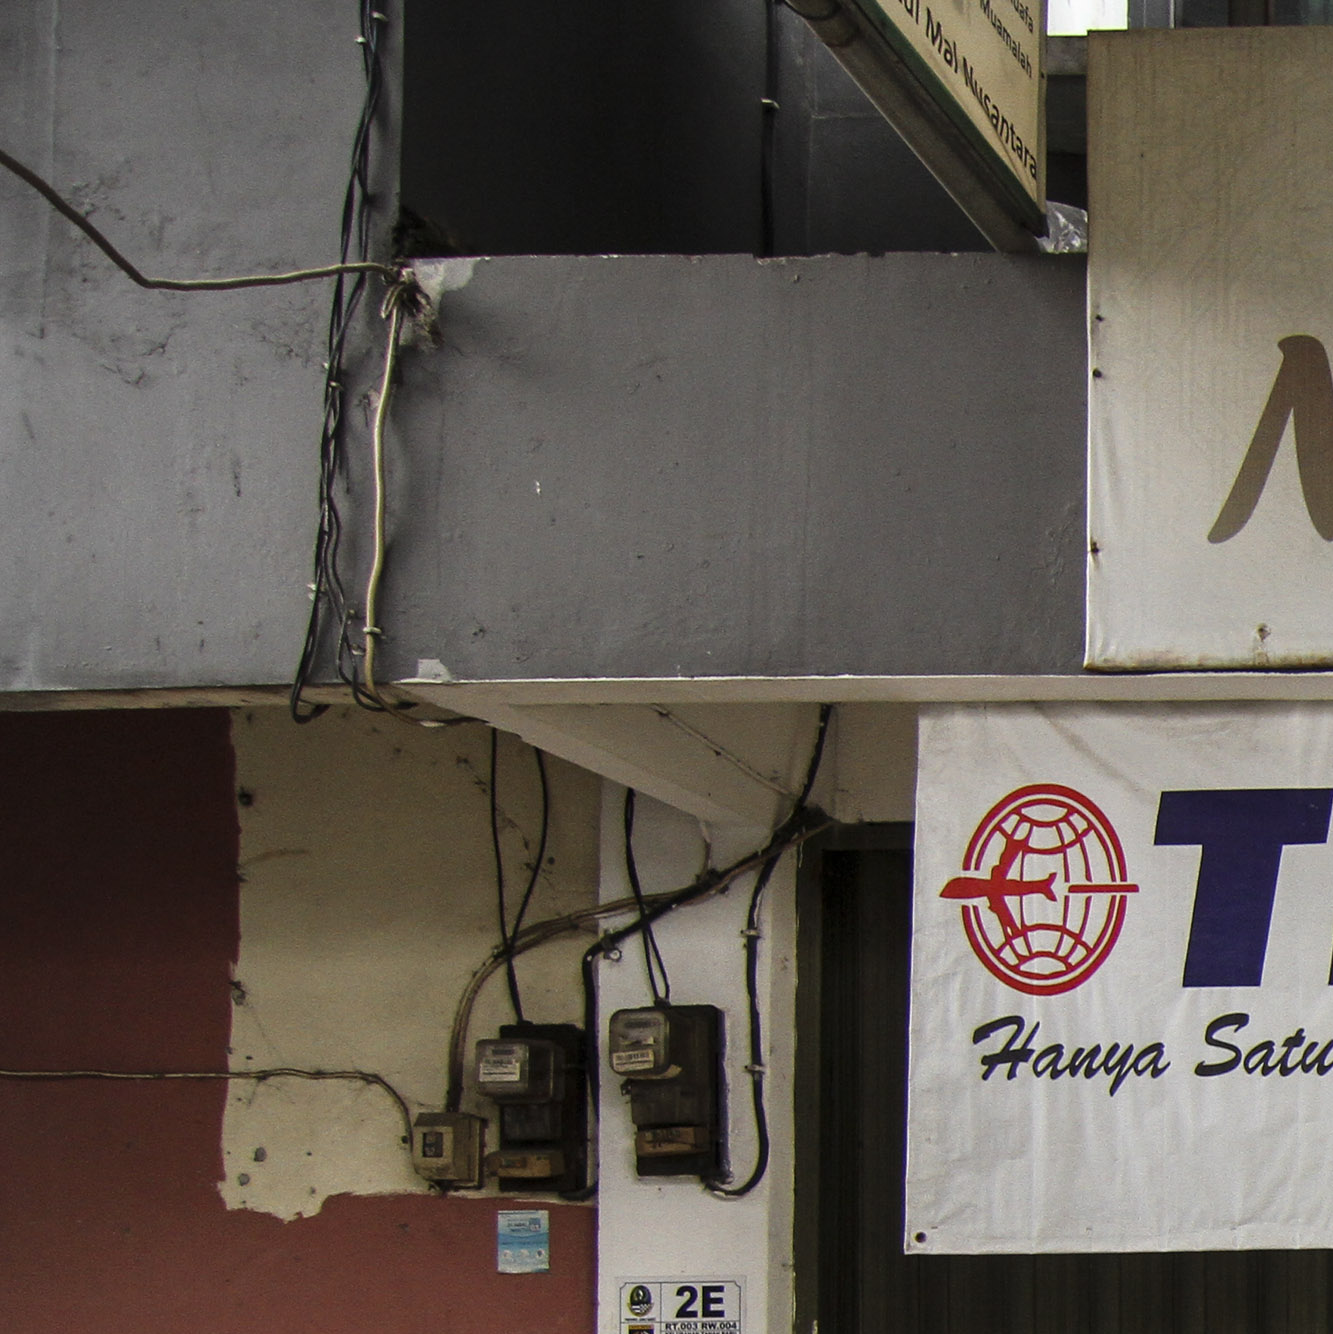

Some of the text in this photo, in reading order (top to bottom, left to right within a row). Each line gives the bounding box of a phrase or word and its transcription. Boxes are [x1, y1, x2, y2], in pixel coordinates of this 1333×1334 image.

[980, 0, 1032, 78] Muamalah
[926, 7, 958, 73] Mal
[963, 56, 1037, 180] Nusantara
[972, 1014, 1172, 1098] Hanya
[674, 1285, 726, 1319] 2E
